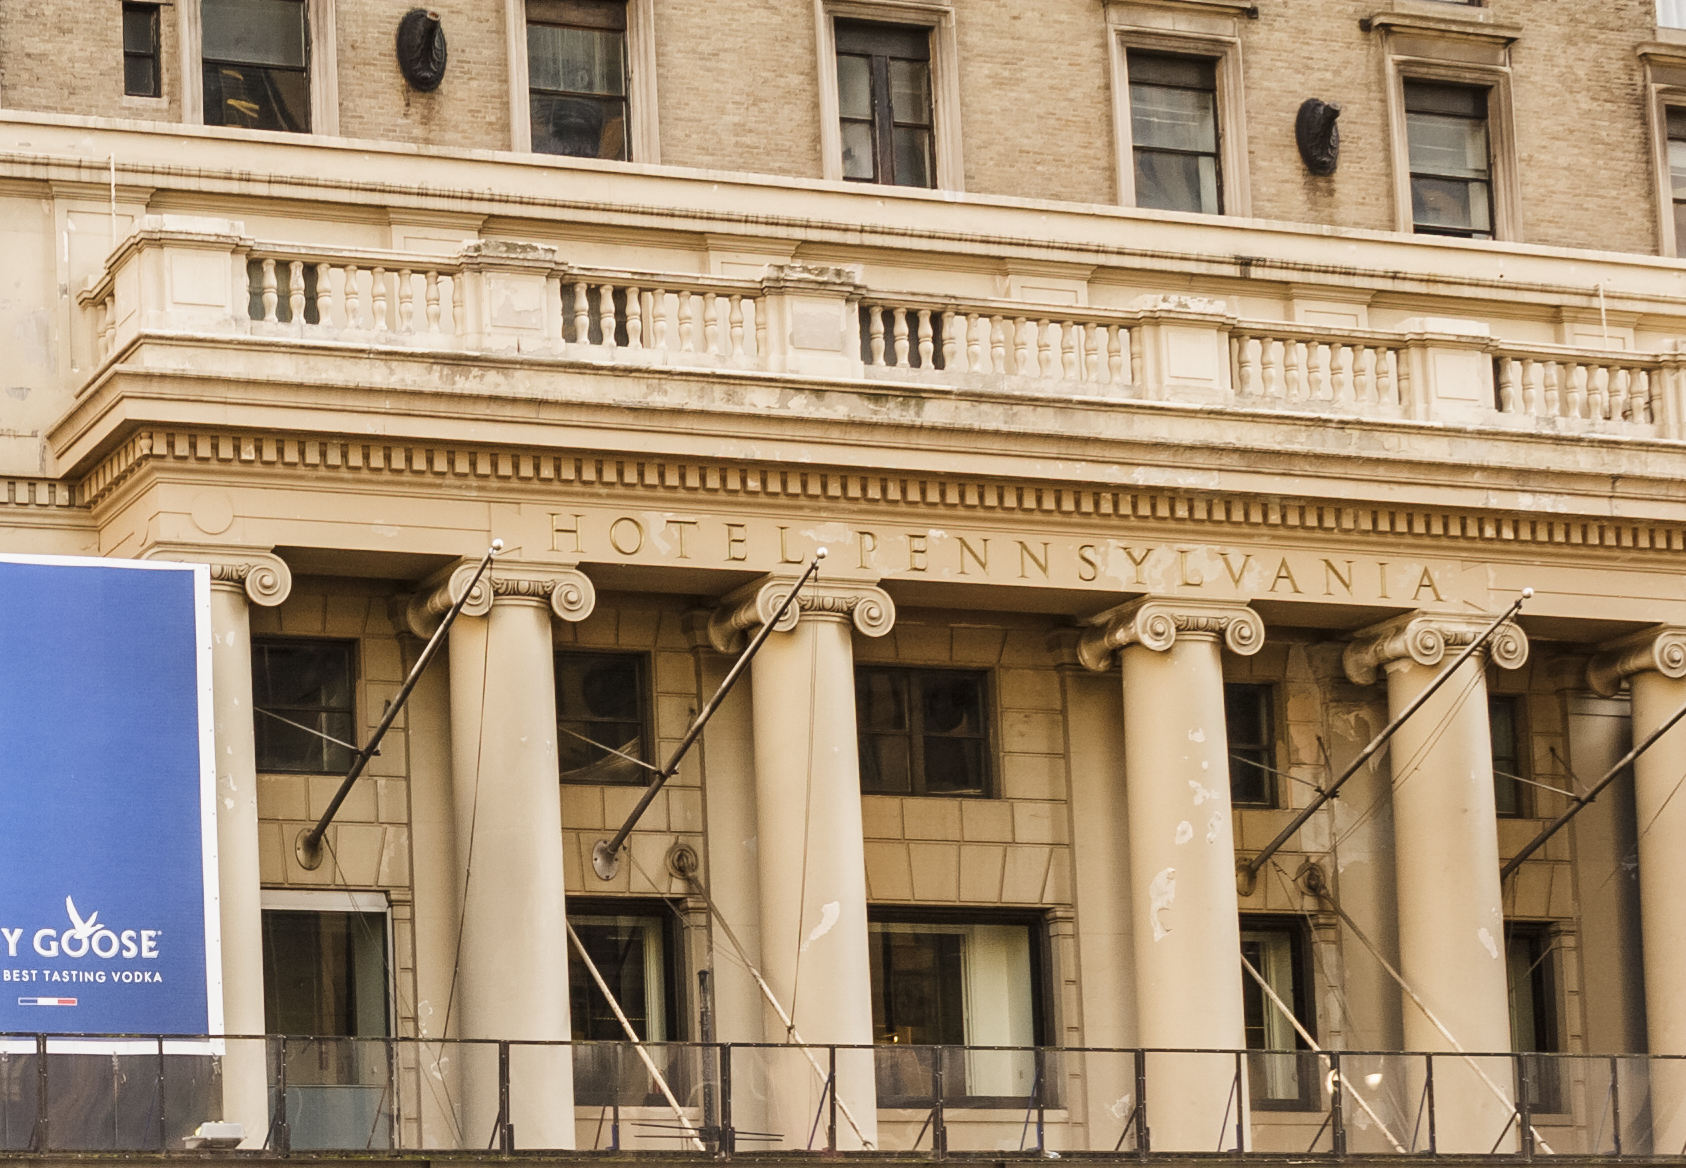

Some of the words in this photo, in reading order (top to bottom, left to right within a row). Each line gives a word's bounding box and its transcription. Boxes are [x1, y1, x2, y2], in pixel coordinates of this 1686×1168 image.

[548, 513, 804, 564] HOTEL
[855, 530, 1444, 602] PENNSYLVANIA
[32, 928, 160, 959] GOOSE
[3, 969, 38, 982] BEST
[43, 970, 106, 983] TASTING
[111, 971, 163, 983] VODKA
